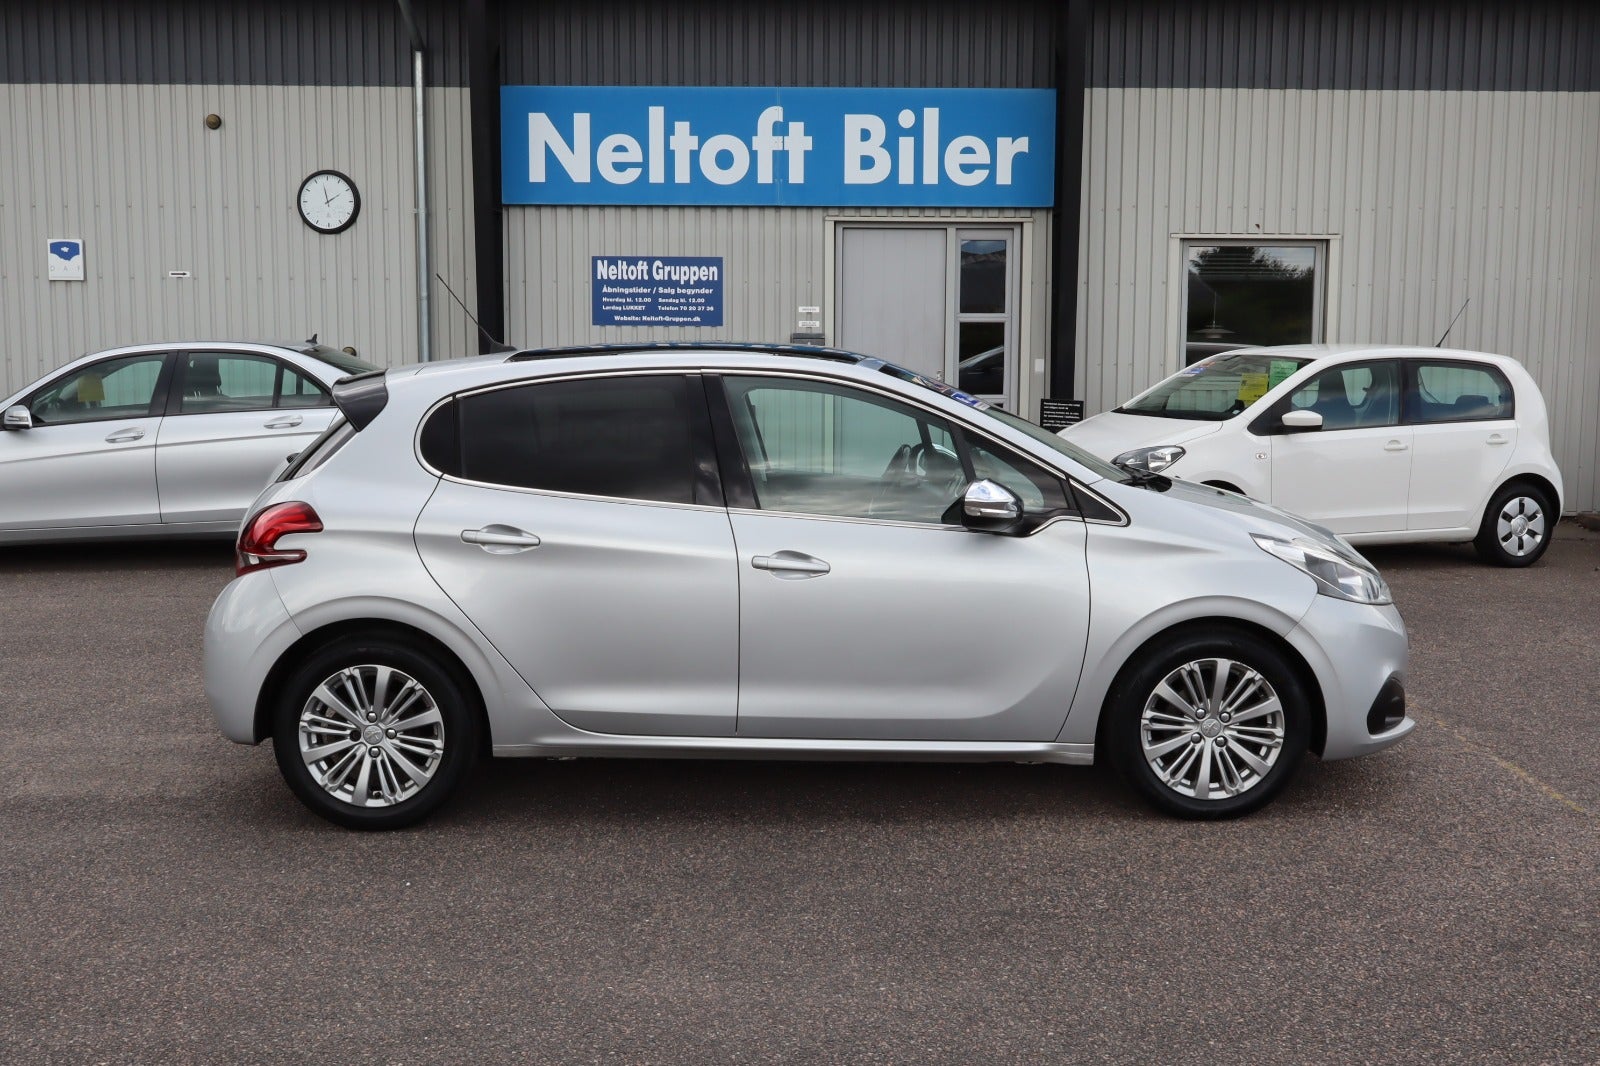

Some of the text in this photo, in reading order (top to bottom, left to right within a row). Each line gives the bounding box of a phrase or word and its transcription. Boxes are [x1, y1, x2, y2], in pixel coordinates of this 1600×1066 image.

[528, 106, 1029, 186] Neltoft Biler
[597, 260, 718, 285] Neltoft Gruppen
[602, 284, 651, 294] Åbningstider
[658, 287, 675, 295] Salg
[676, 287, 713, 295] begynder
